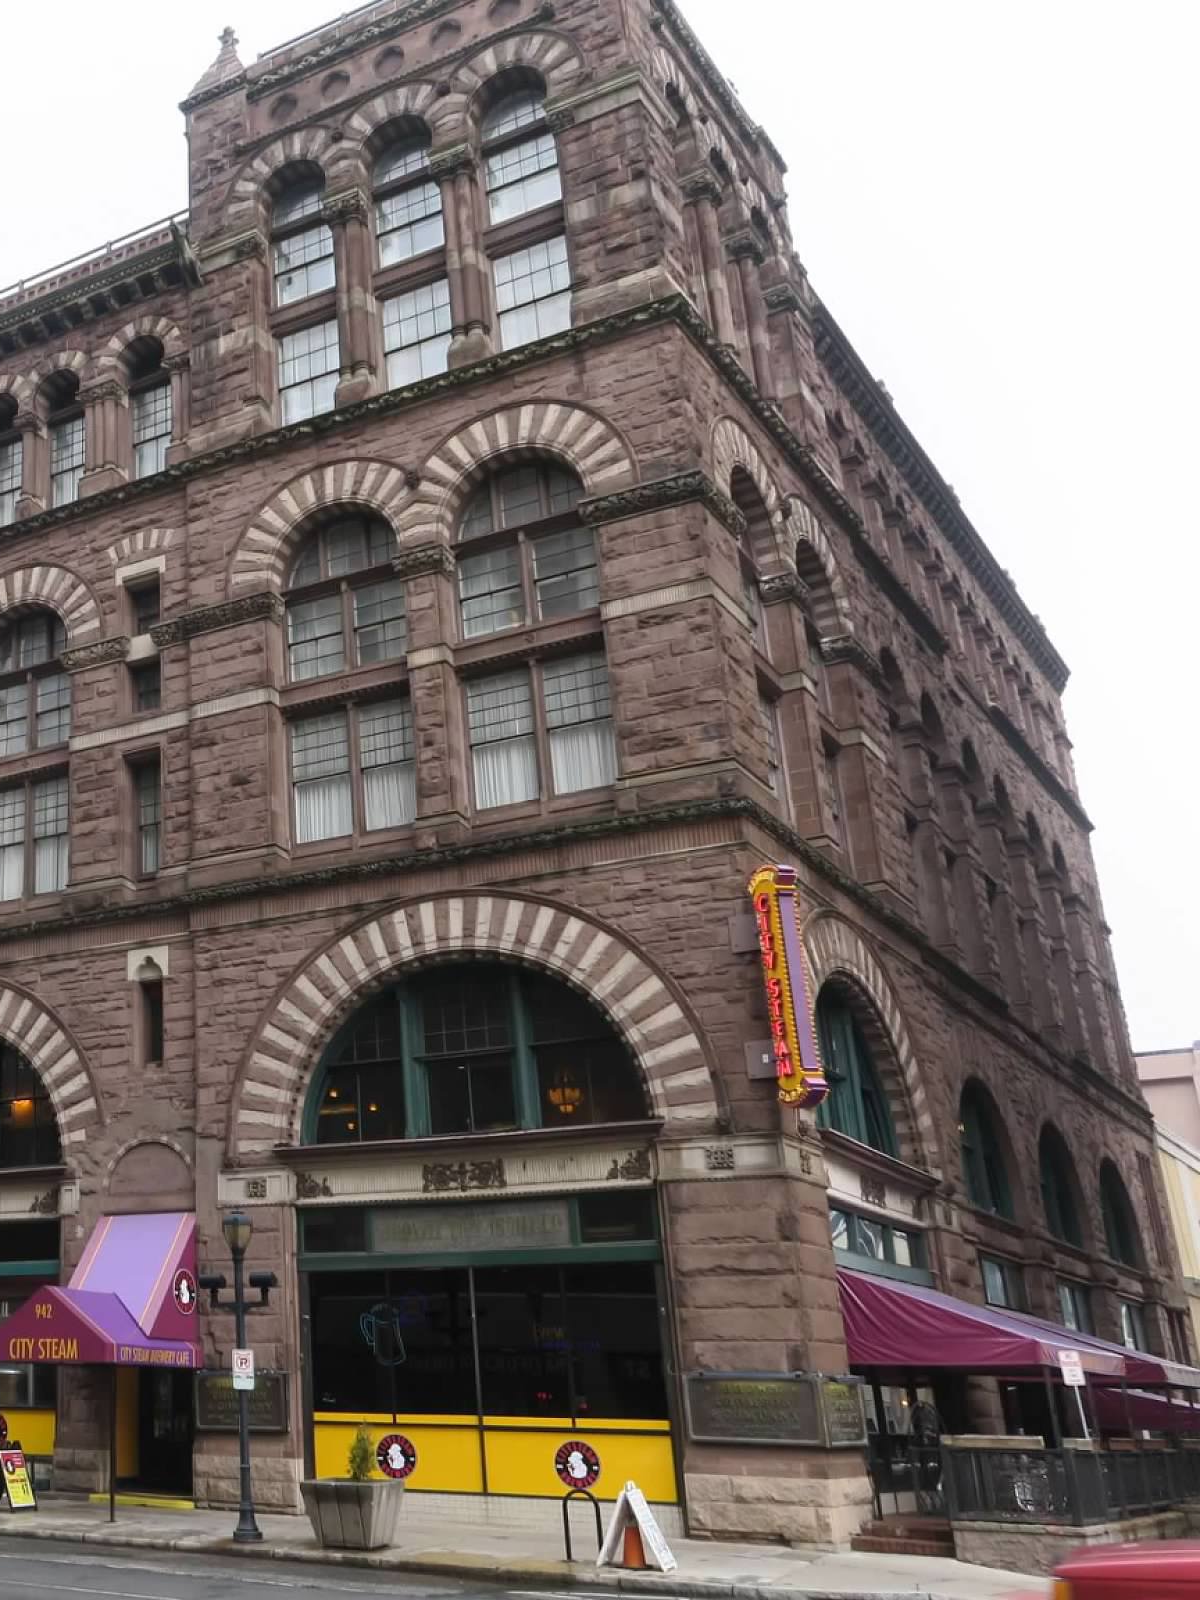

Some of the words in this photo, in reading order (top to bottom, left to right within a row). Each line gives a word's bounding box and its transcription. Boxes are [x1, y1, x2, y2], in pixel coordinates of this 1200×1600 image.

[35, 1303, 53, 1320] 942
[9, 1338, 34, 1360] CITY
[38, 1338, 79, 1360] STEAM
